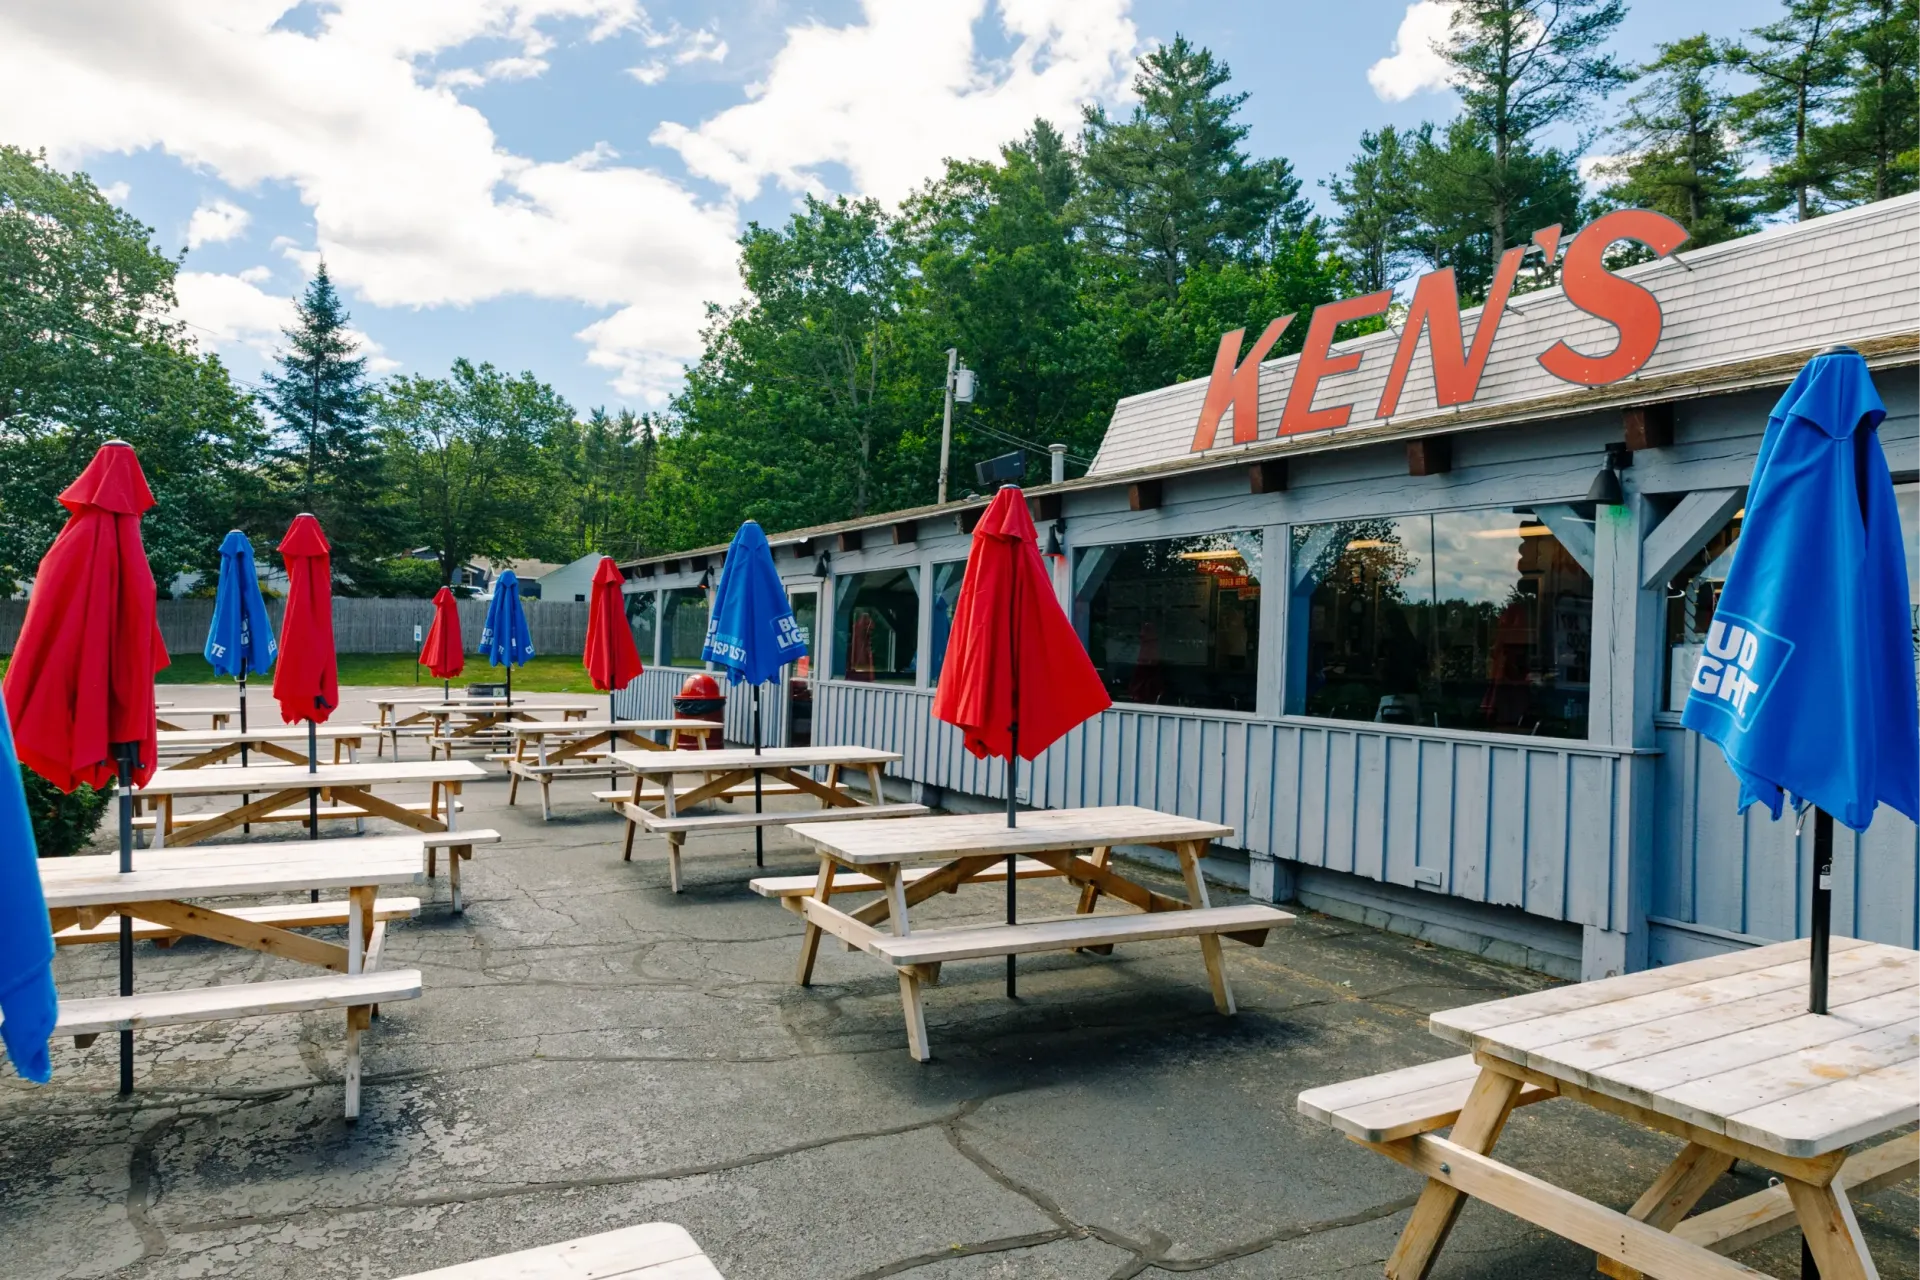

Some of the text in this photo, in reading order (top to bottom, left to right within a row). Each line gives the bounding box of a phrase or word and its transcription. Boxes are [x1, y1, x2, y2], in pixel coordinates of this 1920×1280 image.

[1191, 208, 1690, 453] KEN'S
[777, 629, 804, 649] LIG
[1707, 620, 1758, 670] UD
[1692, 656, 1759, 718] GHT
